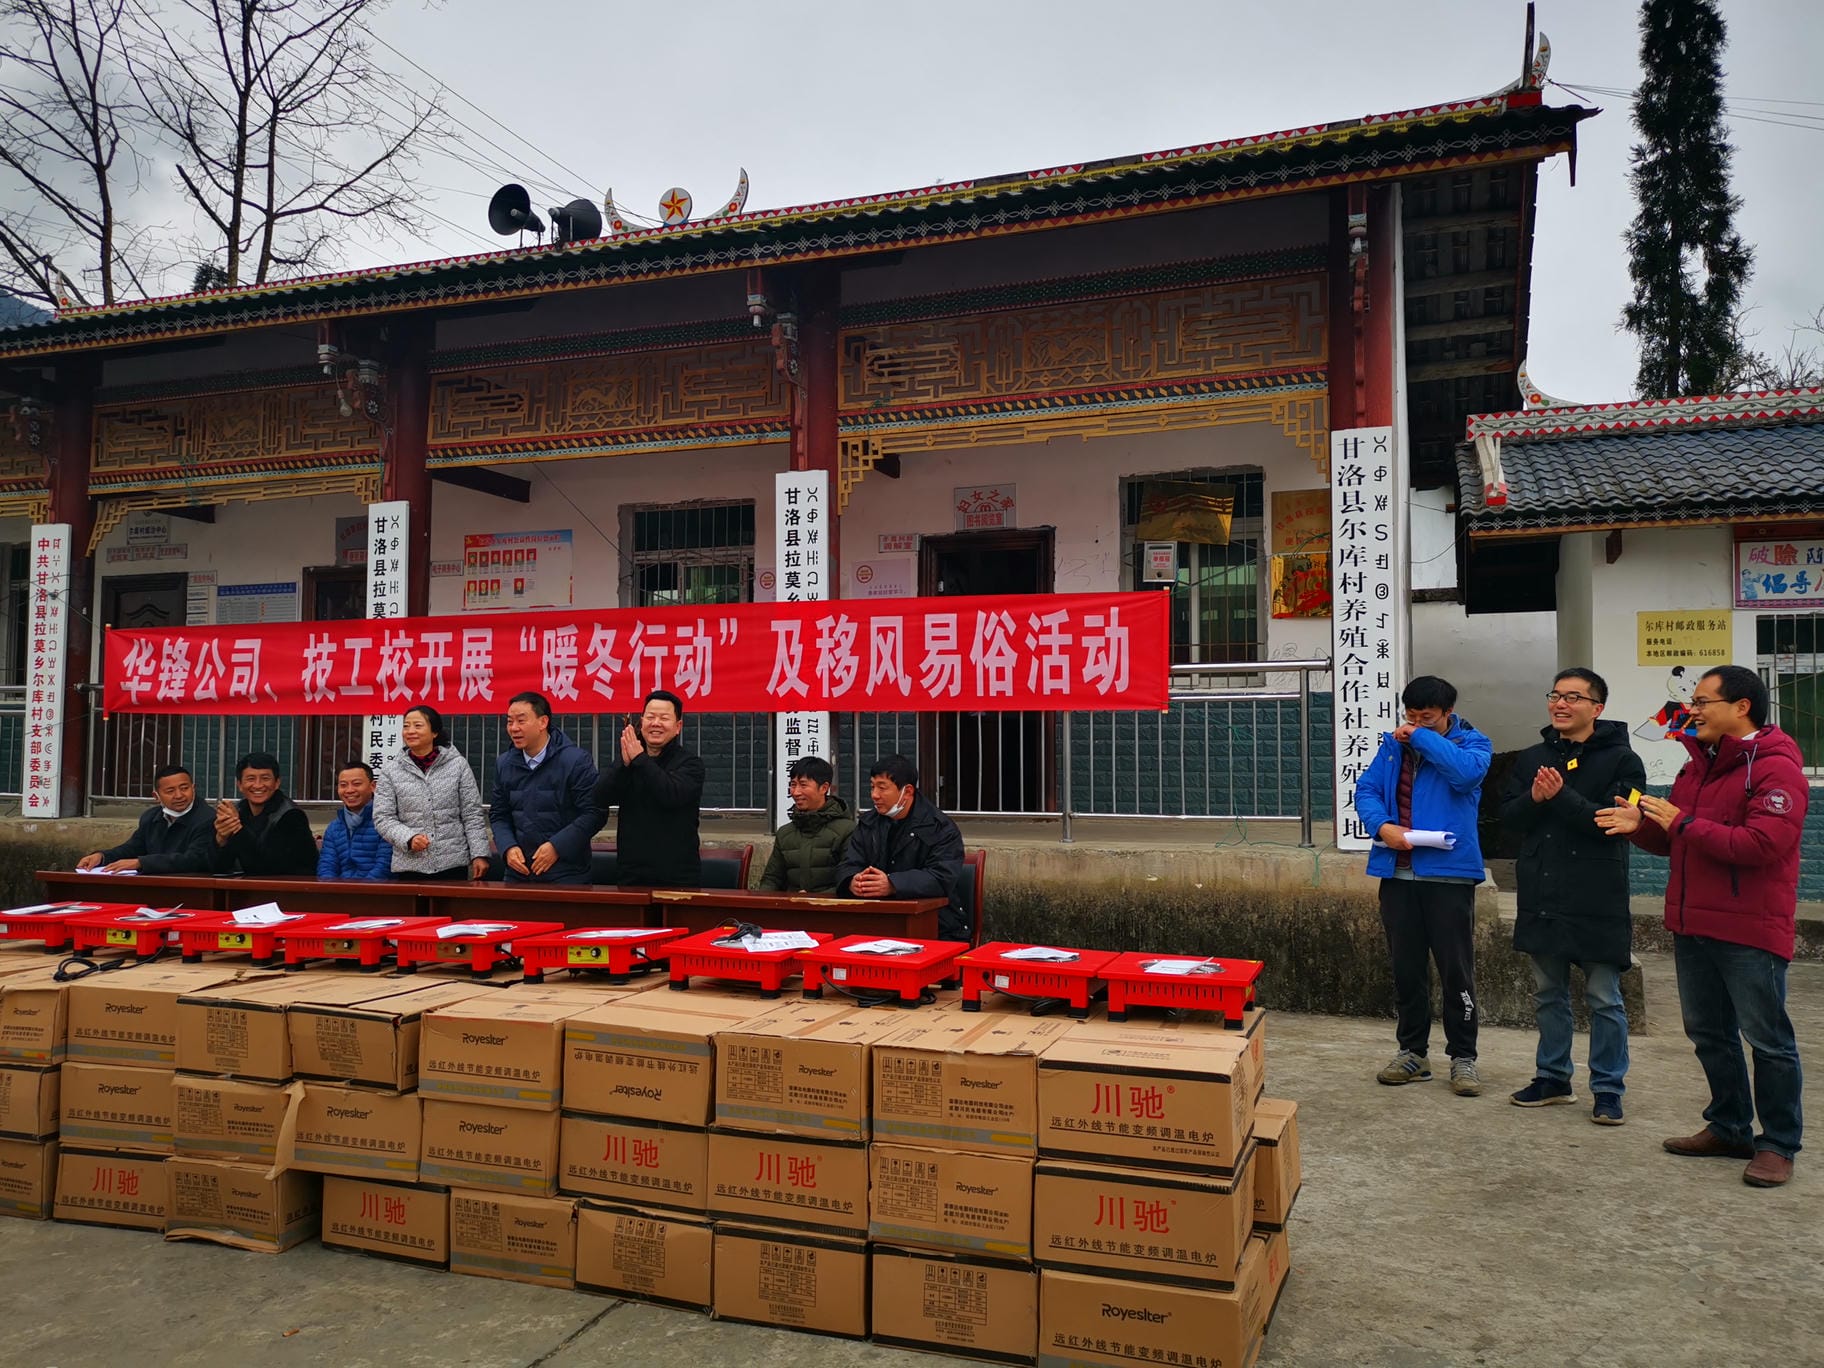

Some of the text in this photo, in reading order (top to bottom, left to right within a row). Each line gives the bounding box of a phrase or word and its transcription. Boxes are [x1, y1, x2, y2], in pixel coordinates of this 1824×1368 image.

[957, 489, 1015, 513] 妇女之家
[1762, 569, 1824, 594] 倡导
[1645, 619, 1726, 633] 尔库村邮政服务站
[28, 537, 50, 808] 中共甘洛县拉莫乡尔库村支部委员会
[1091, 1083, 1165, 1120] 川驰
[1051, 1115, 1215, 1143] 远红外线节能变频调温电炉
[603, 1134, 660, 1169] 川驰
[93, 1167, 139, 1195] 川驰
[755, 1151, 817, 1189] 川驰
[360, 1191, 406, 1226] 川驰
[717, 1183, 853, 1212] 远红外线节能变频调温电炉
[1094, 1195, 1171, 1235] 川驰
[1050, 1233, 1217, 1265] 远红外线节能变频调温电炉
[1054, 1332, 1223, 1368] 远红外线节能变频调温电炉
